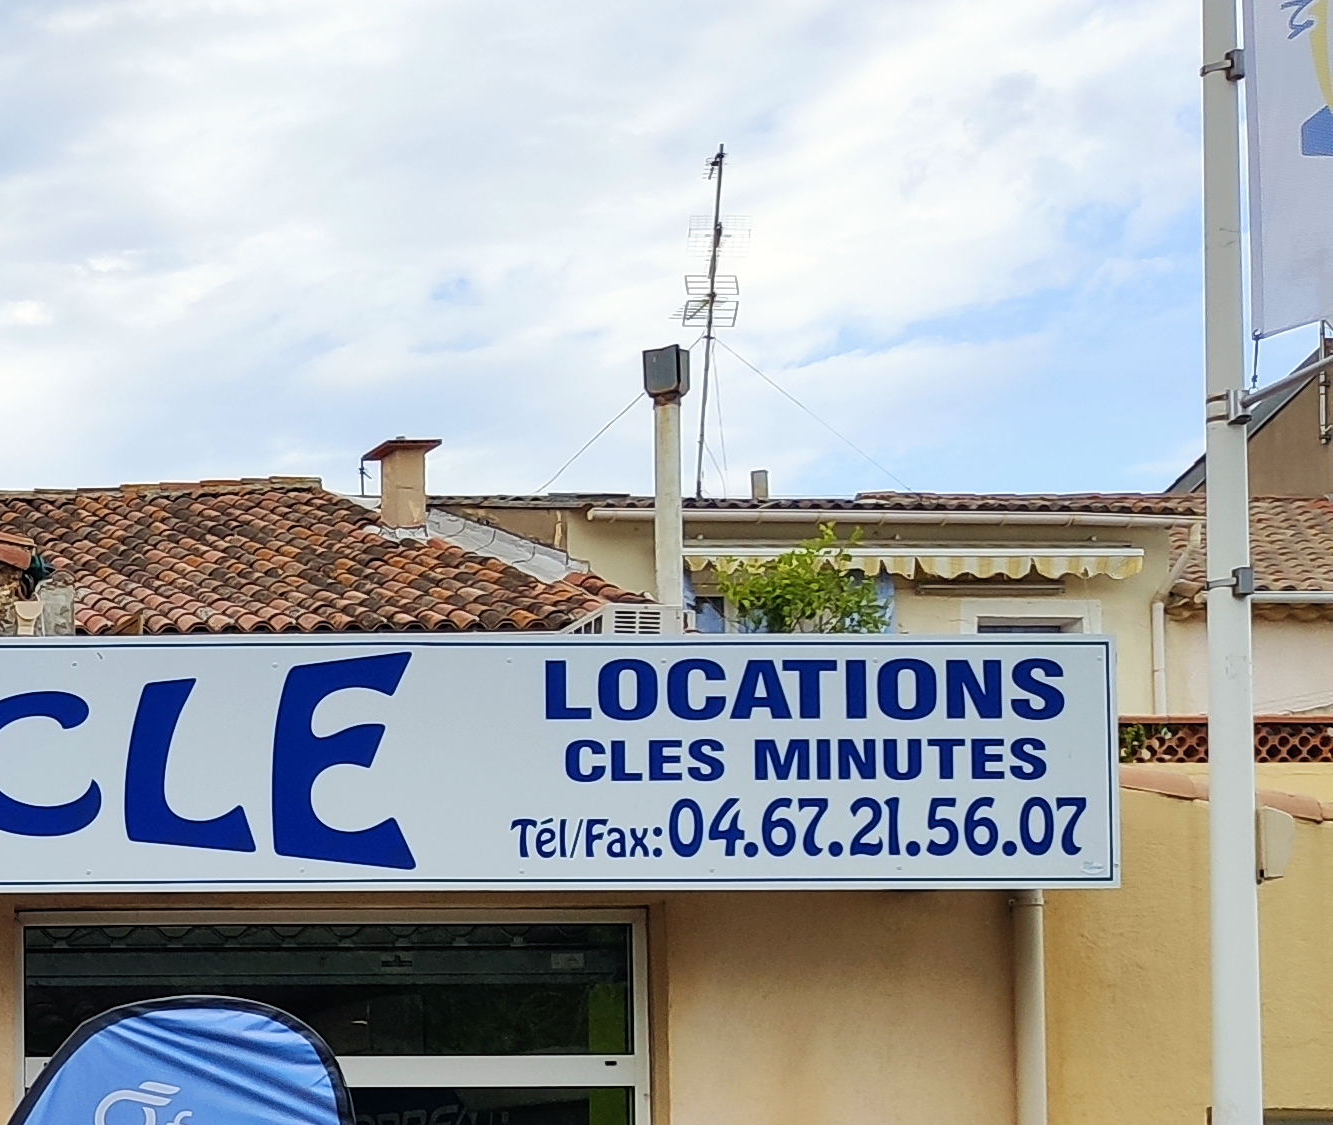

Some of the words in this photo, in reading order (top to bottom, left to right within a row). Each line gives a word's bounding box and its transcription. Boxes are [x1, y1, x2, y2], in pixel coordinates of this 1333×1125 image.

[544, 657, 1065, 721] LOCATIONS
[565, 738, 725, 782] CLES
[753, 737, 1047, 781] MINUTES
